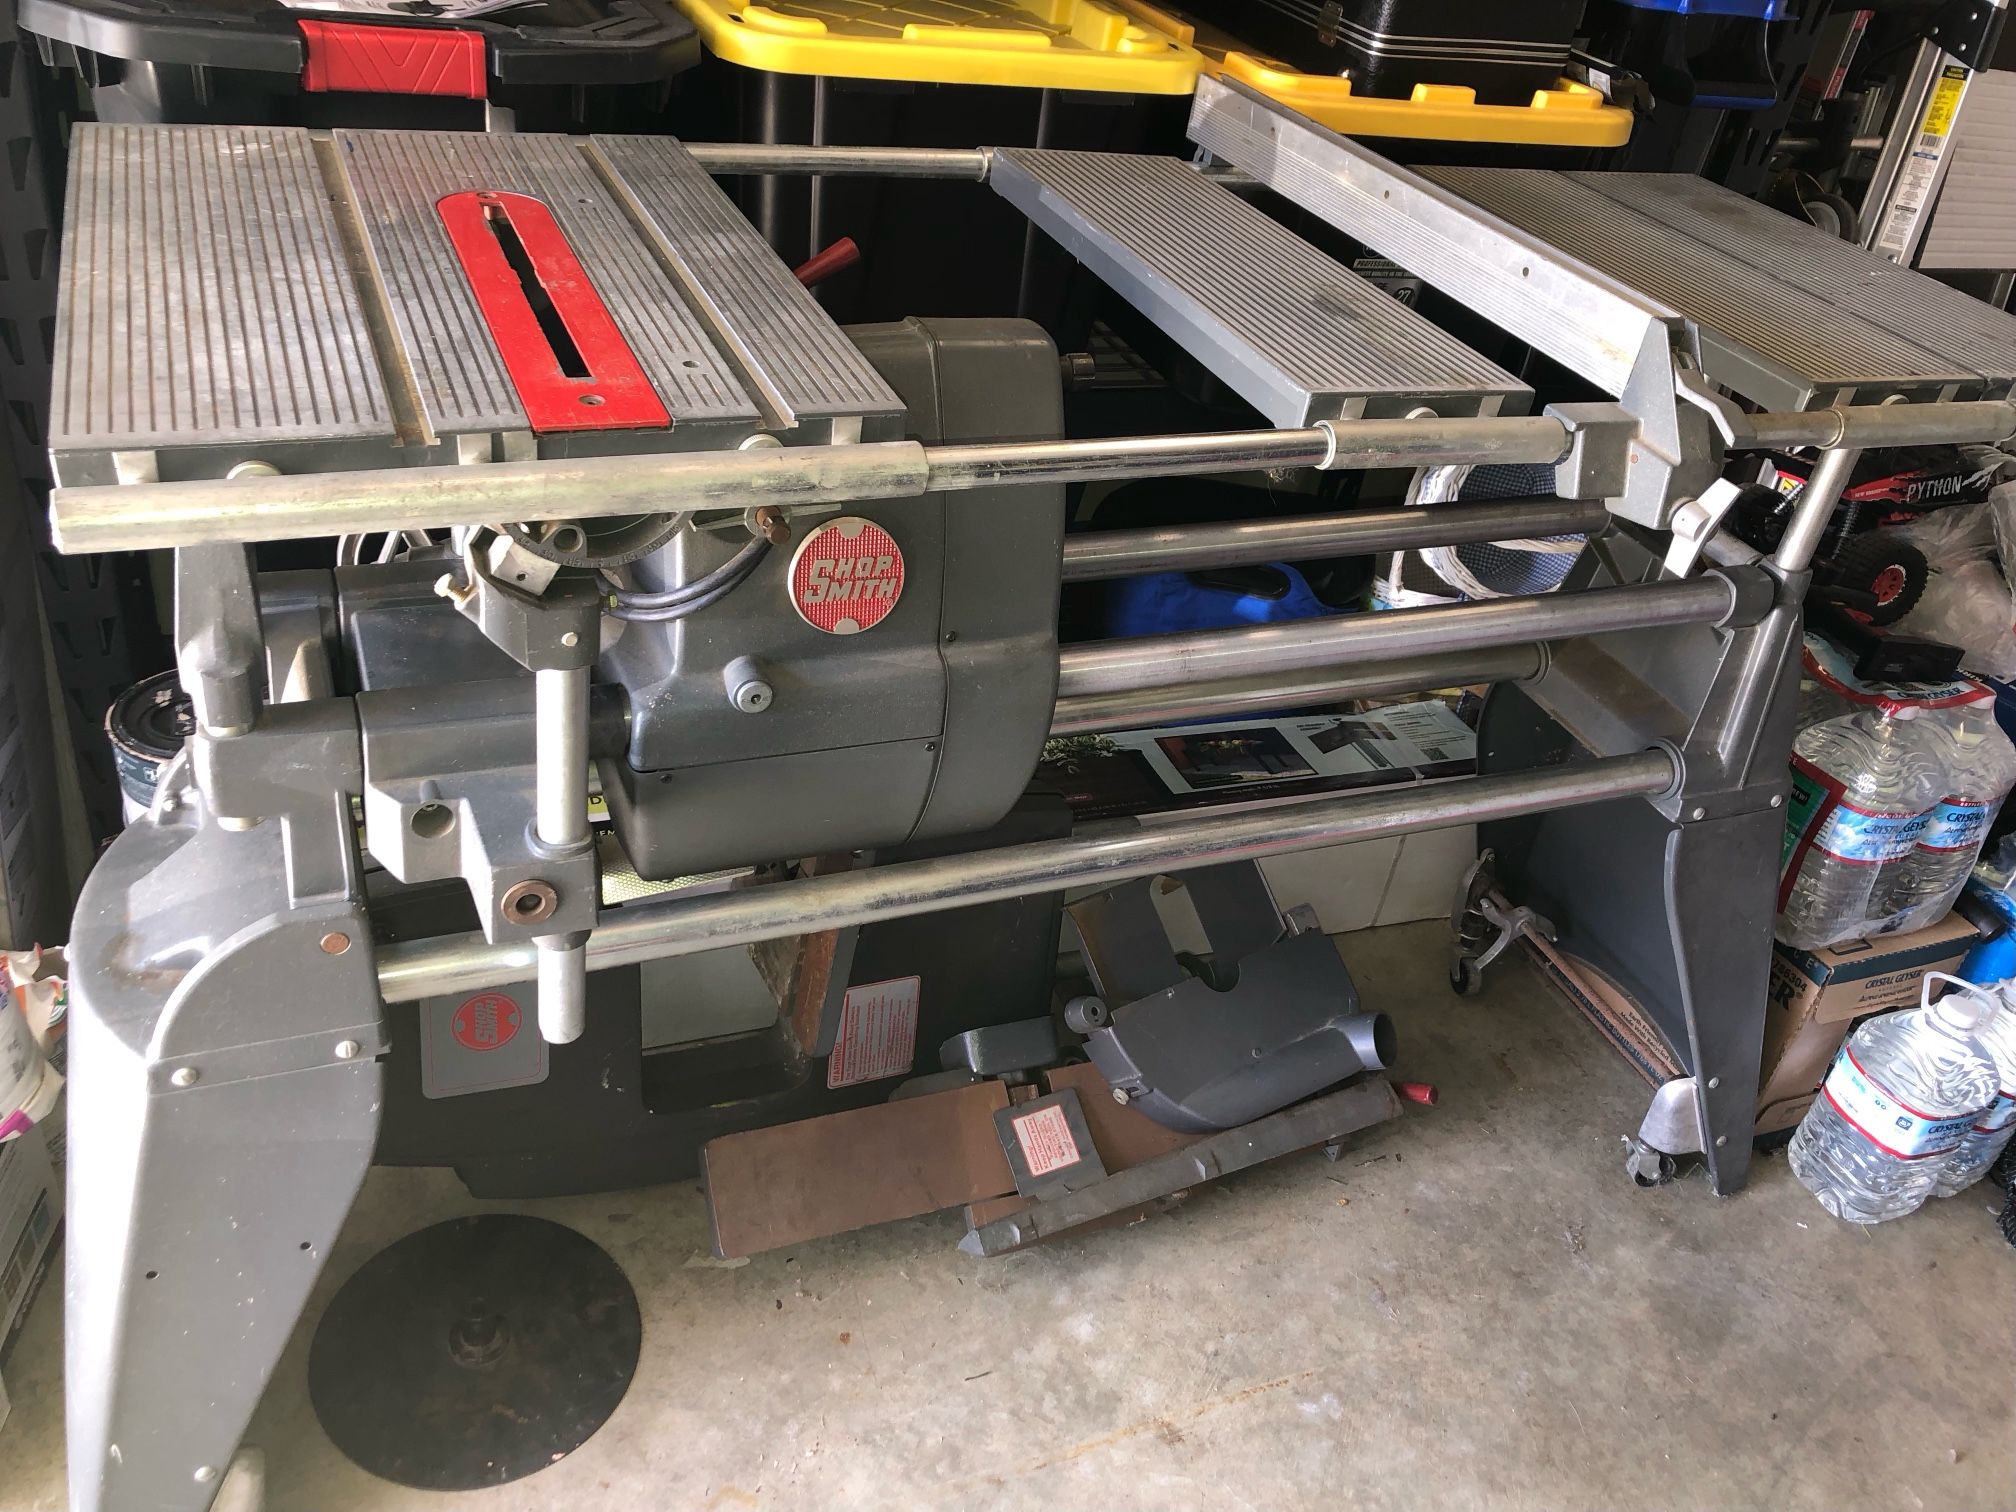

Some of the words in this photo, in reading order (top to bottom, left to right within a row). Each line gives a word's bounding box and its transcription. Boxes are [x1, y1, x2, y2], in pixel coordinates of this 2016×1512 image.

[1906, 474, 1963, 502] PYTHON
[804, 555, 894, 585] SHOP
[803, 574, 898, 604] SMITH
[1026, 1118, 1036, 1133] Away
[1033, 1134, 1044, 1153] Hands
